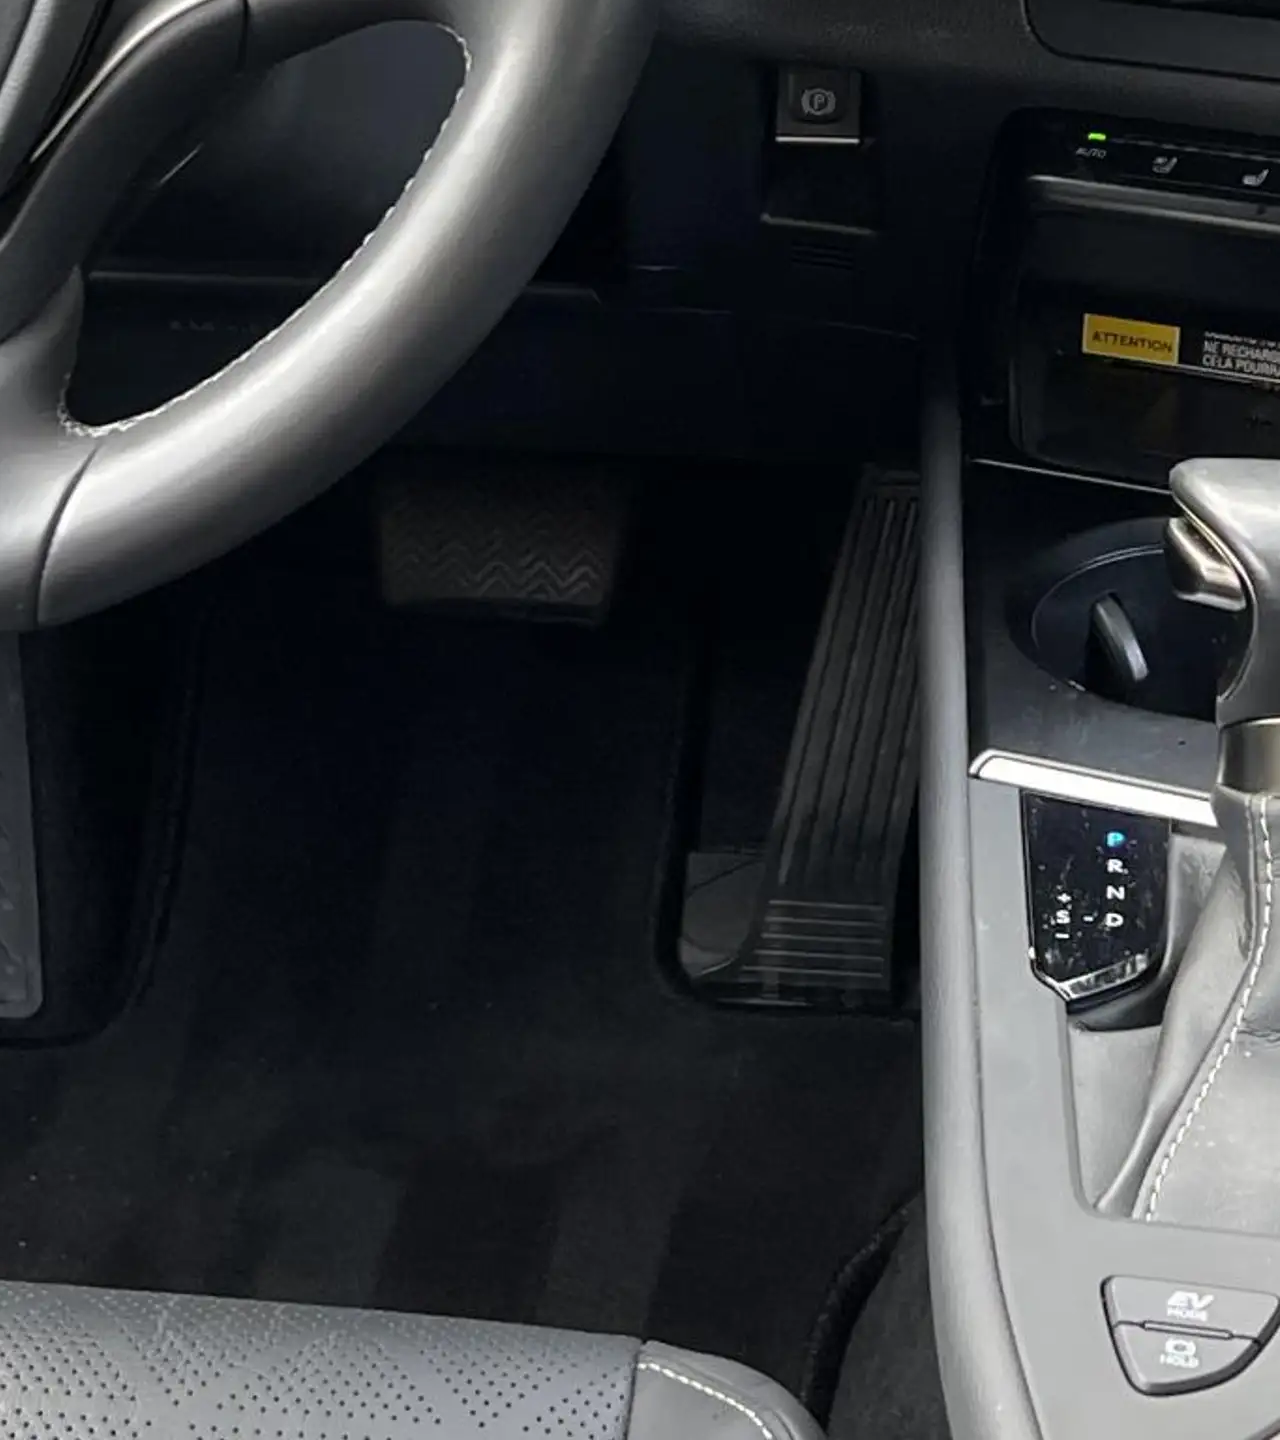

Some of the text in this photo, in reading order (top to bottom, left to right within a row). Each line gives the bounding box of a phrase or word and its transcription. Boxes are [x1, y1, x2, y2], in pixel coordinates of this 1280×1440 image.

[1091, 330, 1173, 354] ATTENTION
[1202, 354, 1234, 369] CELA
[1106, 831, 1125, 847] P
[1107, 859, 1124, 873] R
[1106, 886, 1125, 900] N
[1056, 910, 1071, 924] S
[1105, 913, 1124, 927] D
